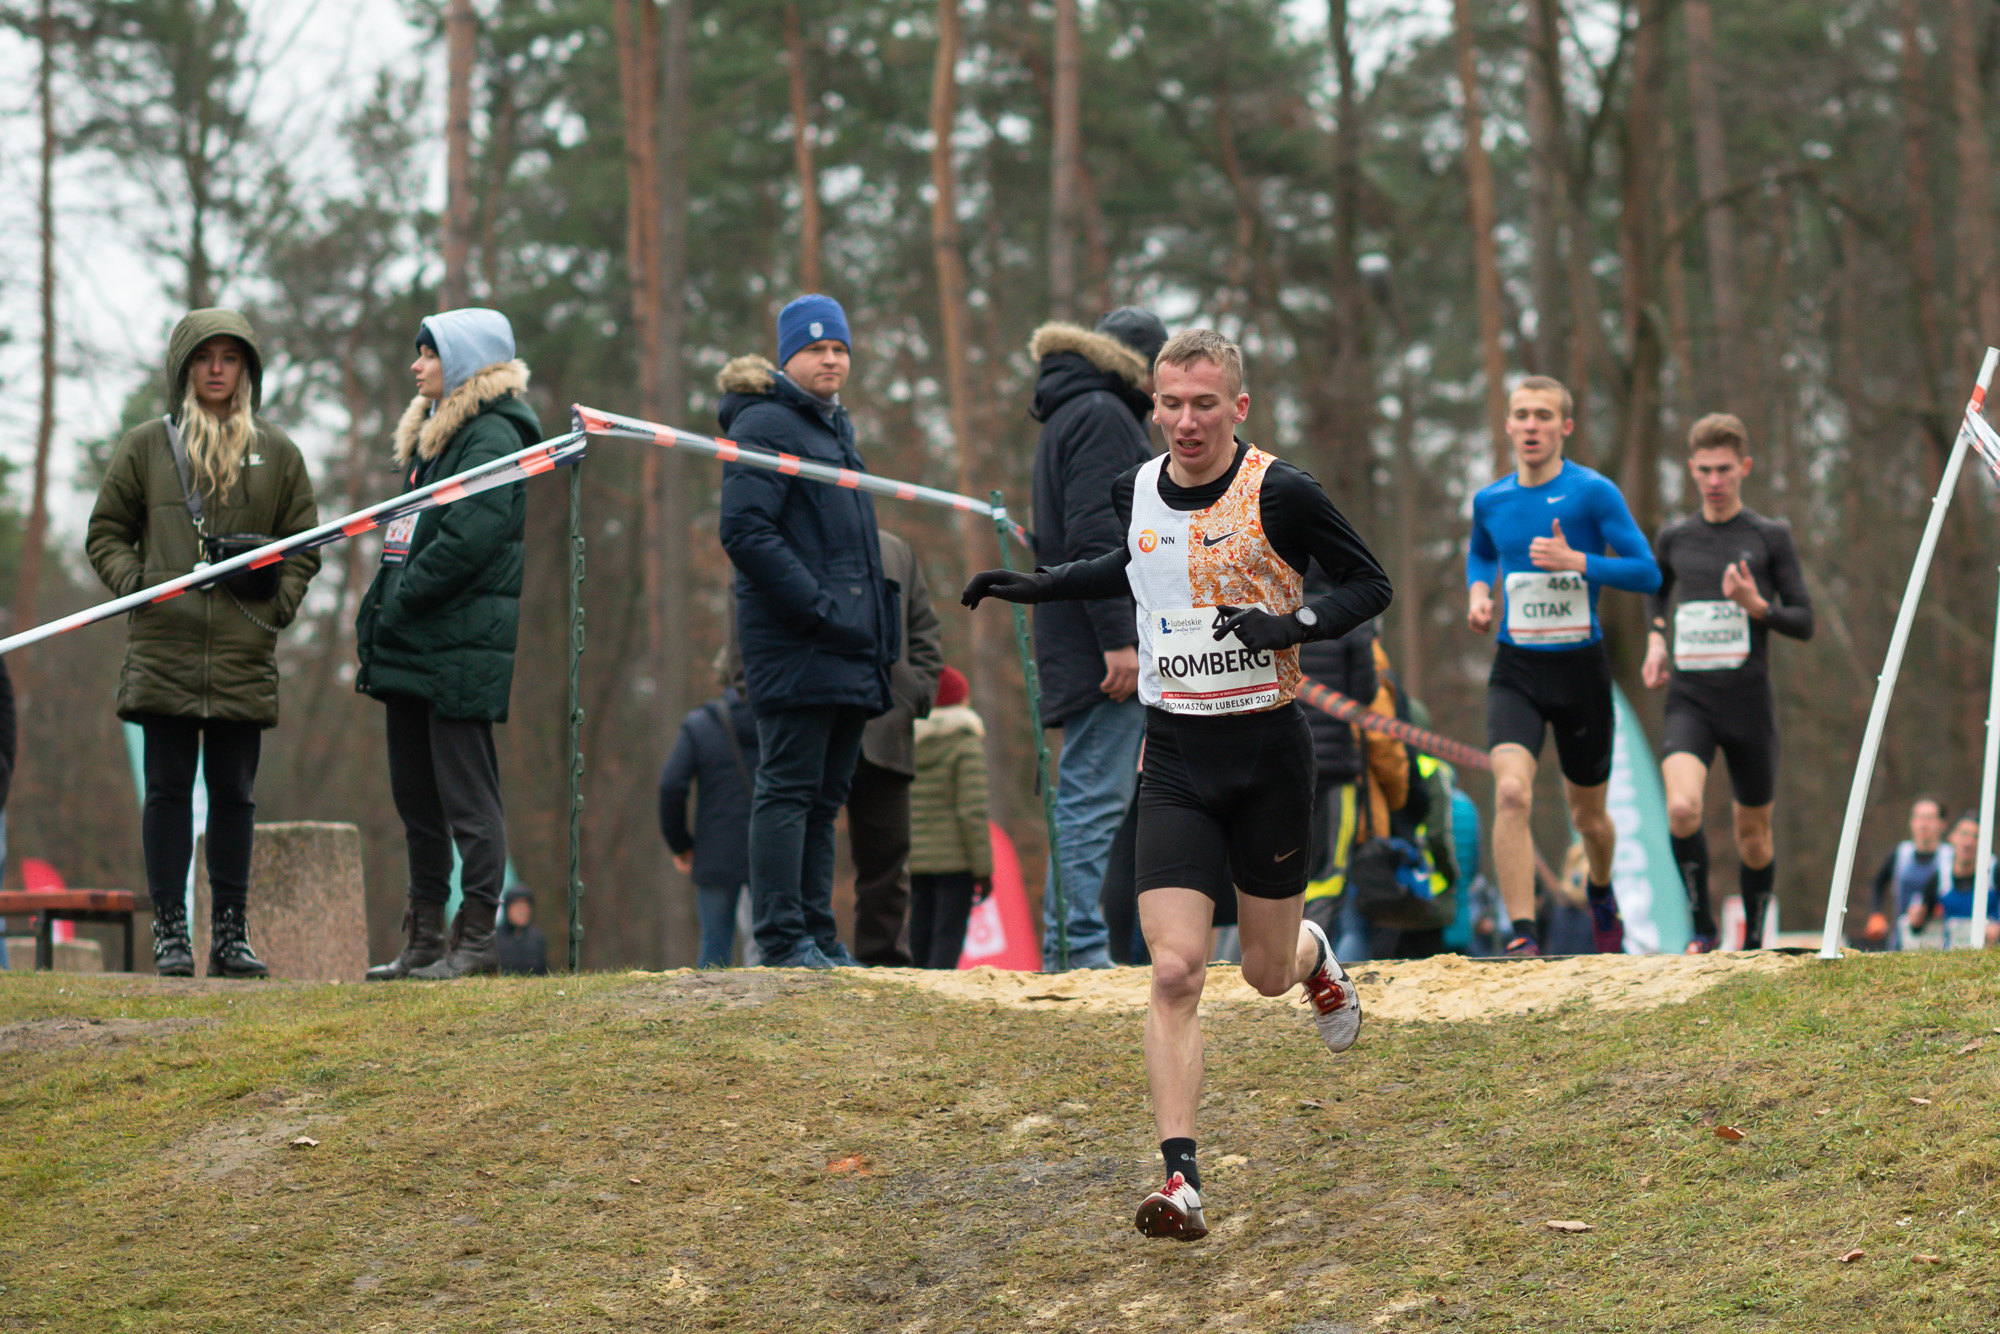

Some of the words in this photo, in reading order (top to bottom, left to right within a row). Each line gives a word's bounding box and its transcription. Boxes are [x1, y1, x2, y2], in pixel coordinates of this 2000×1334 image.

[1161, 536, 1175, 545] NN
[1547, 576, 1582, 591] 461
[1523, 601, 1572, 618] CITAK
[1711, 605, 1742, 620] 204
[1158, 649, 1271, 678] ROMBERG
[1166, 701, 1213, 711] TOMASZÓW
[1215, 697, 1254, 710] LUBELSKI
[1255, 693, 1276, 704] 2021
